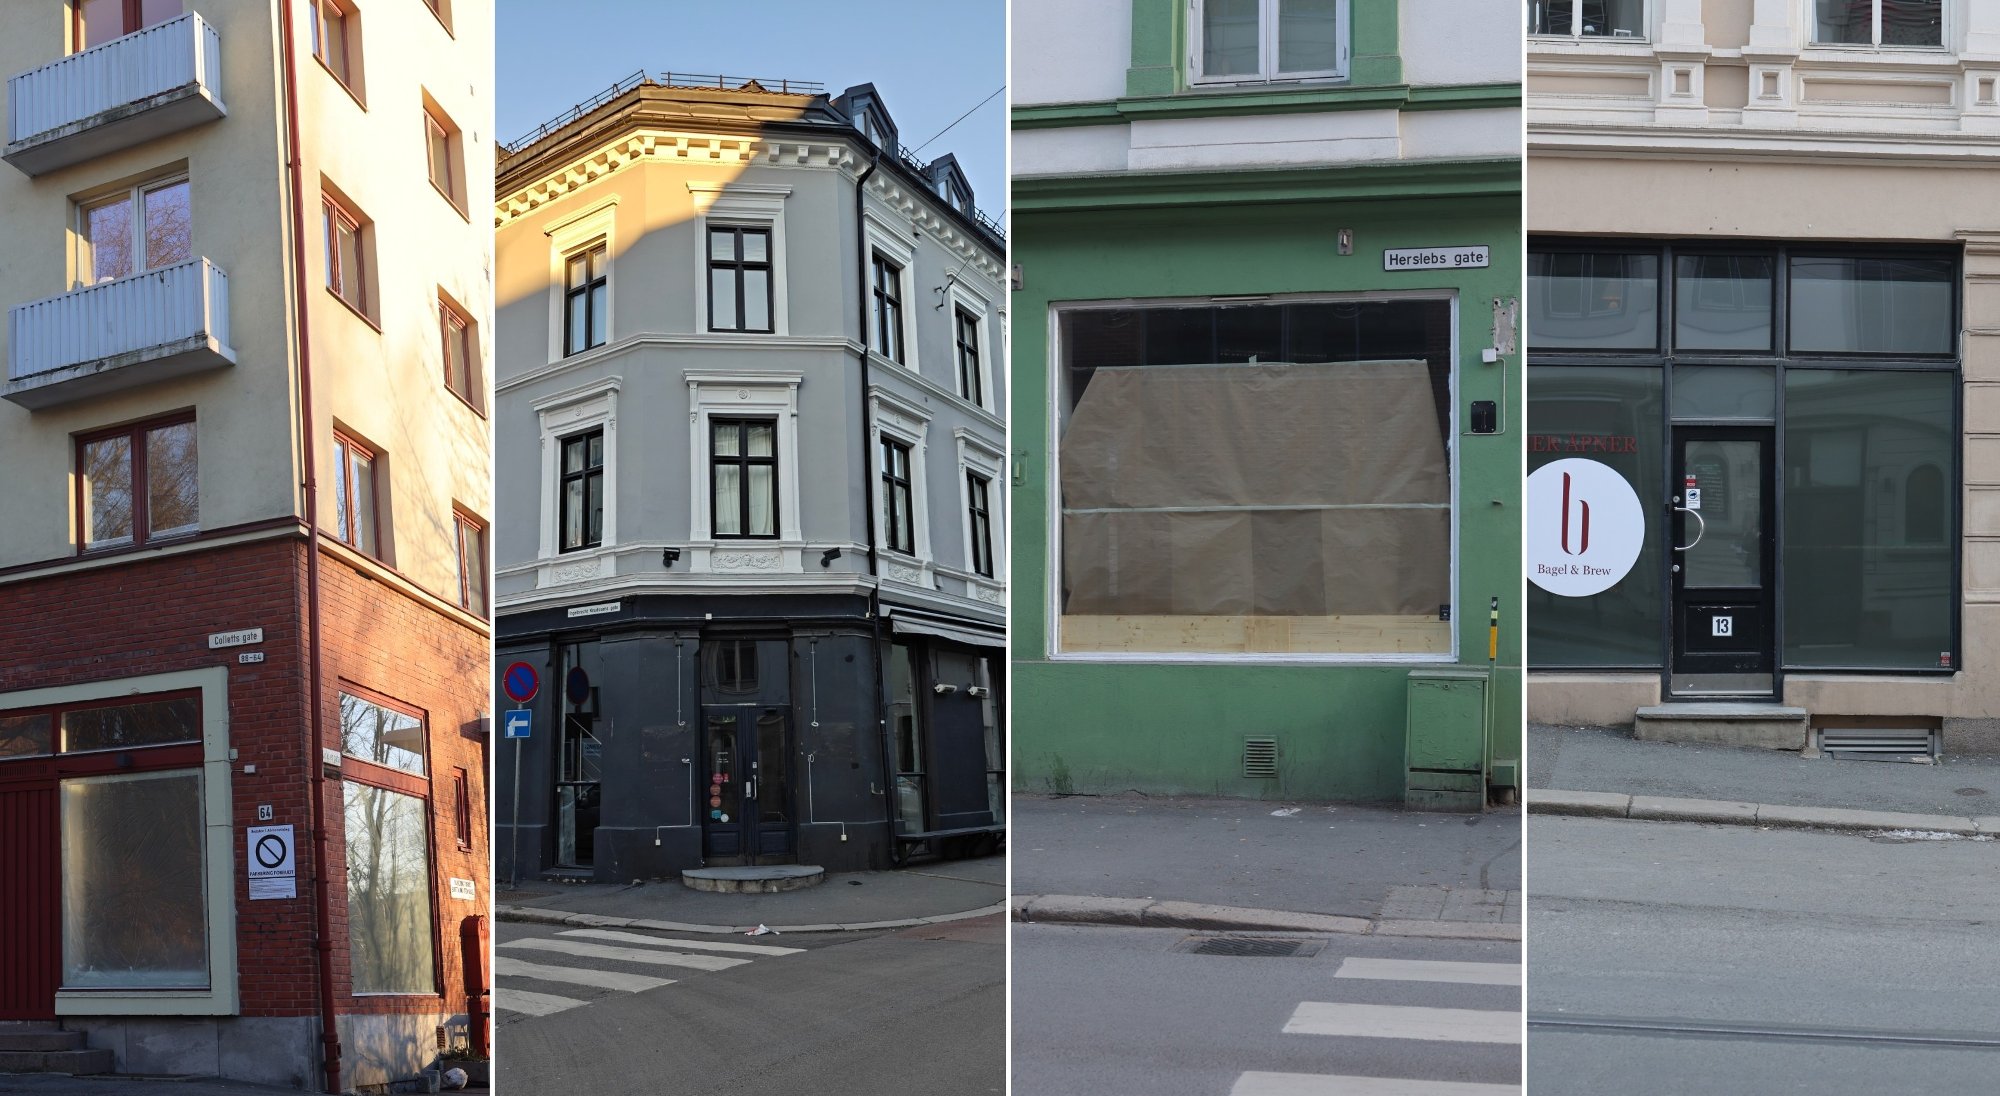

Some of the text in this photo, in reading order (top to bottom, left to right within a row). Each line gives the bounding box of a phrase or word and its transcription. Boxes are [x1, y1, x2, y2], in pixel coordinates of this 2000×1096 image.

[1389, 251, 1484, 266] Herslebs gate
[1565, 432, 1638, 453] ÅPNER
[1537, 563, 1612, 577] Bagel & Brew
[1715, 618, 1729, 634] 13
[214, 631, 258, 645] Colletts gate
[260, 807, 271, 818] 64
